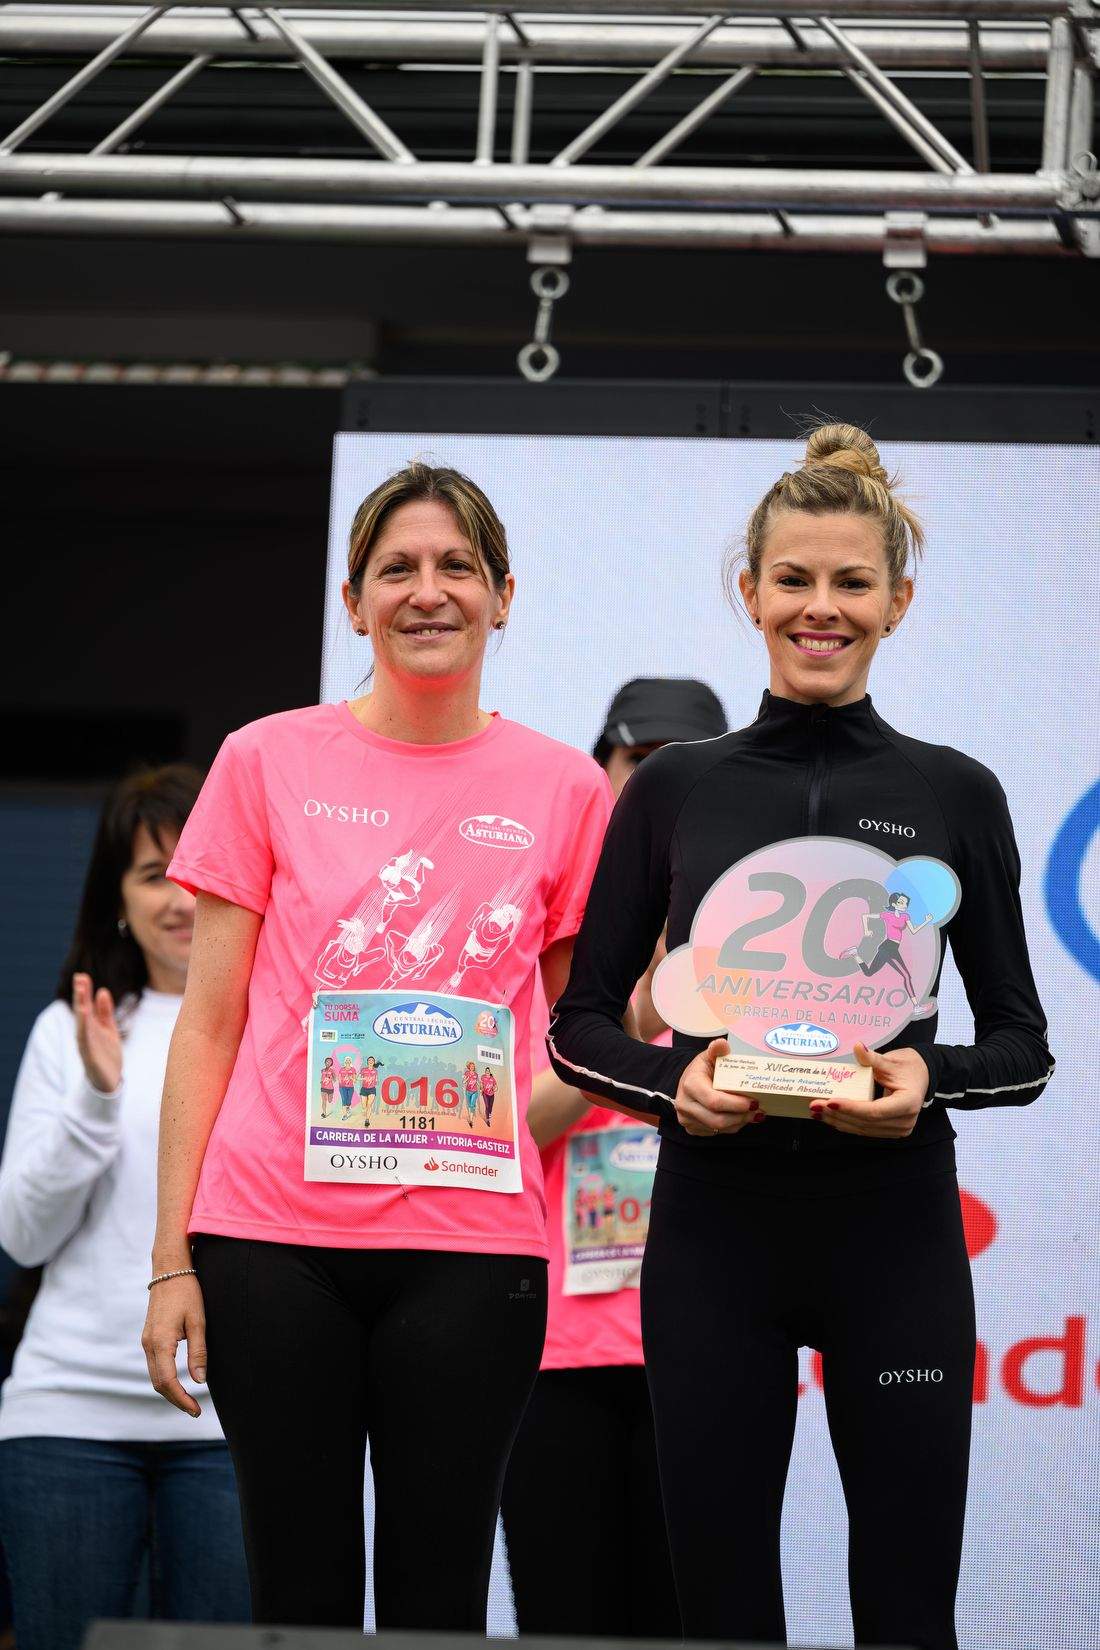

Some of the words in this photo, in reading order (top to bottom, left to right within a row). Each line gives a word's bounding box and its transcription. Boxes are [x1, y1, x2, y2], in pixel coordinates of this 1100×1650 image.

[303, 799, 390, 827] OYSHO
[465, 823, 529, 846] ASTURIANA
[858, 818, 916, 839] OYSHO
[717, 871, 888, 979] 20
[695, 974, 908, 1009] ANIVERSARIO
[324, 1011, 360, 1022] SUMA
[480, 1014, 495, 1031] 20
[723, 1003, 790, 1021] CARRERA
[796, 1009, 814, 1022] DE
[819, 1010, 838, 1024] LA
[842, 1012, 892, 1028] MUJER
[380, 1016, 458, 1039] ASTURIANA
[770, 1032, 833, 1049] ASTURIANA
[781, 1064, 811, 1075] Carrera
[821, 1068, 827, 1076] la
[826, 1066, 857, 1083] Mujer
[381, 1075, 460, 1109] 016
[751, 1081, 794, 1092] Clasificada
[797, 1085, 834, 1095] Absoluta
[399, 1115, 436, 1130] 1181
[315, 1130, 361, 1143] CARRERA
[363, 1133, 376, 1143] DE
[379, 1133, 391, 1143] LA
[394, 1133, 428, 1144] MUJER
[437, 1135, 510, 1154] VITORIA-GASTEIZ
[330, 1153, 398, 1170] OYSHO
[441, 1160, 499, 1177] Santander
[878, 1368, 944, 1386] OYSHO
